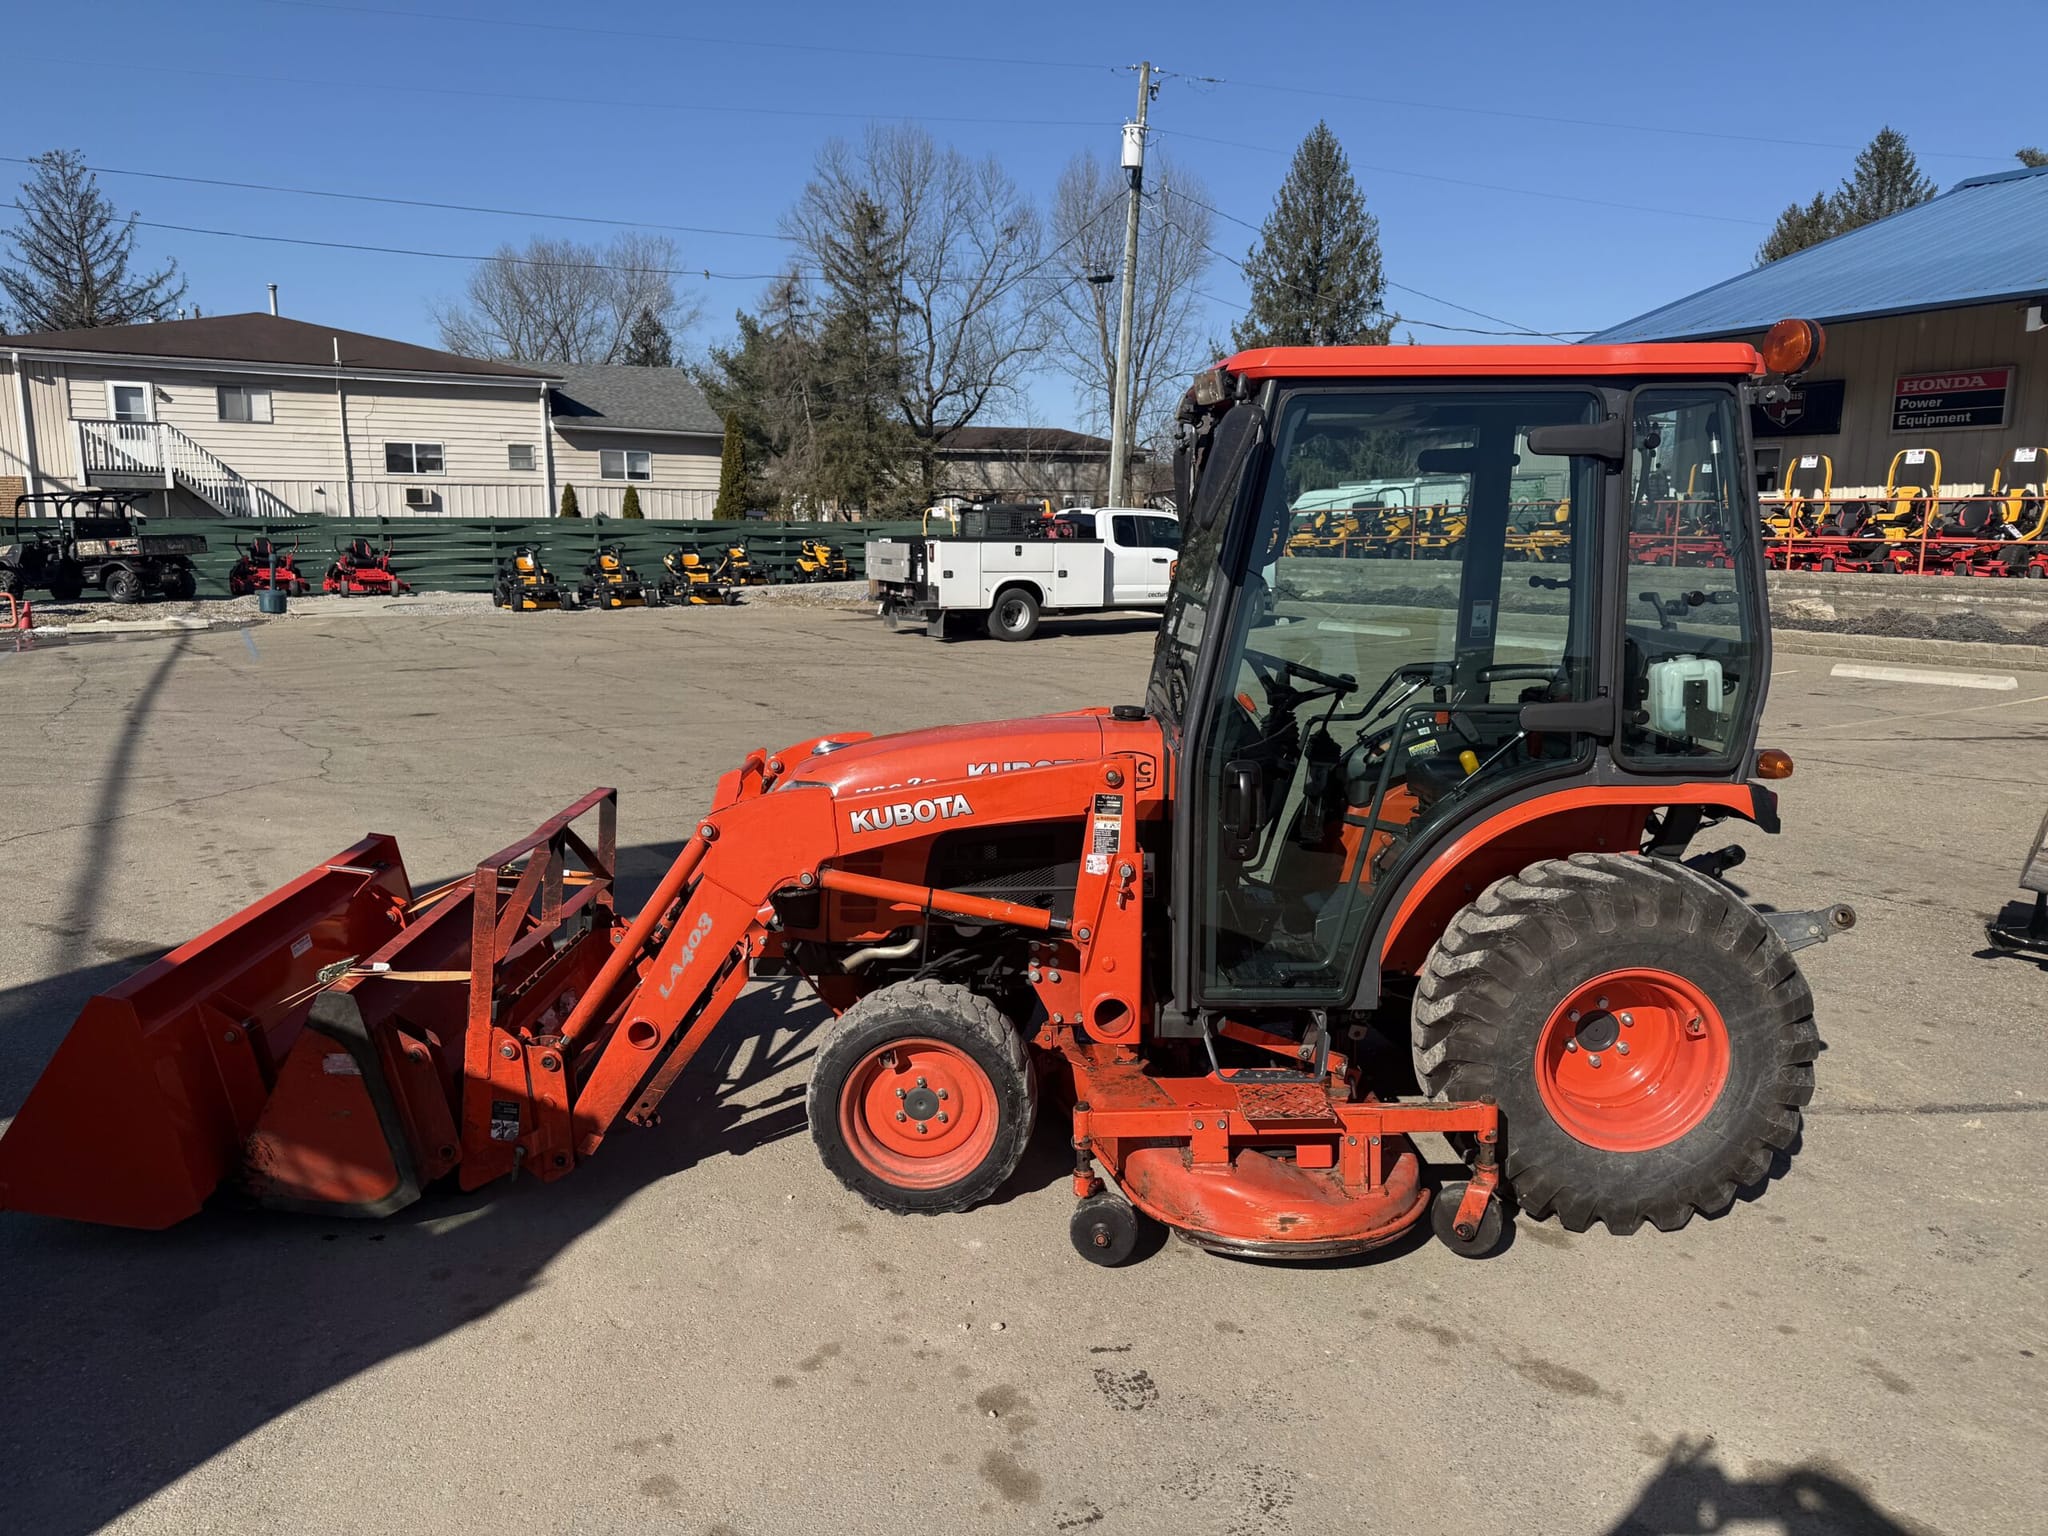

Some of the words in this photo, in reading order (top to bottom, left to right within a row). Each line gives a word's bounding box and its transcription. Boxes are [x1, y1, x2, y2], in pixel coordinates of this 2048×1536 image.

[1902, 375, 1987, 392] HONDA
[1900, 398, 1943, 410] Power
[1898, 412, 1972, 427] Equipment
[850, 793, 974, 833] KUBOTA
[659, 912, 713, 999] LA403
